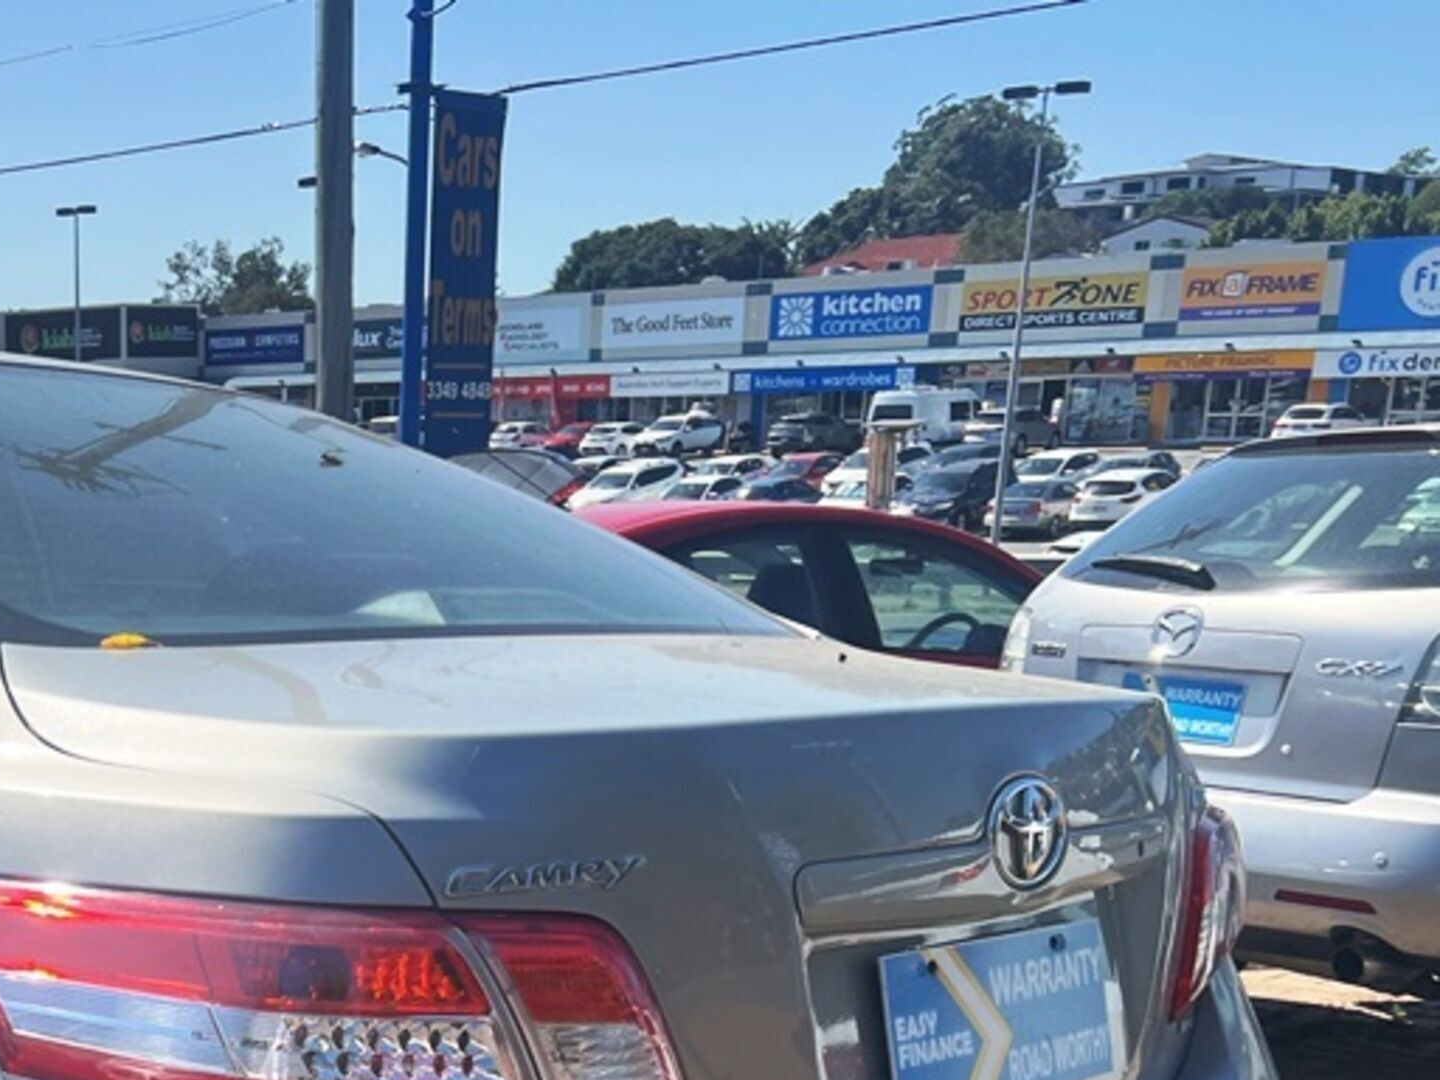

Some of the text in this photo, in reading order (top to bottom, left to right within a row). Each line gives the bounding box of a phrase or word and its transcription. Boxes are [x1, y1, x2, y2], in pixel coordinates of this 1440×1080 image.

[438, 113, 499, 189] Cars
[450, 209, 482, 256] on
[1186, 278, 1220, 298] FIX
[1246, 273, 1320, 296] FRAME
[431, 279, 492, 346] Terms
[823, 291, 922, 317] kitchen
[964, 315, 1015, 330] DIRECT
[1078, 309, 1138, 325] CENTRE
[612, 312, 734, 335] The Good Feet Store
[820, 314, 921, 336] connection
[754, 369, 892, 388] kitchens wardrobes
[1165, 685, 1243, 709] WARRANTY
[444, 855, 648, 897] CAMRY
[988, 947, 1102, 1004] WARRANTY
[894, 1010, 938, 1042] EASY
[897, 1031, 975, 1070] FINANCE
[1052, 1026, 1109, 1070] WORTHY
